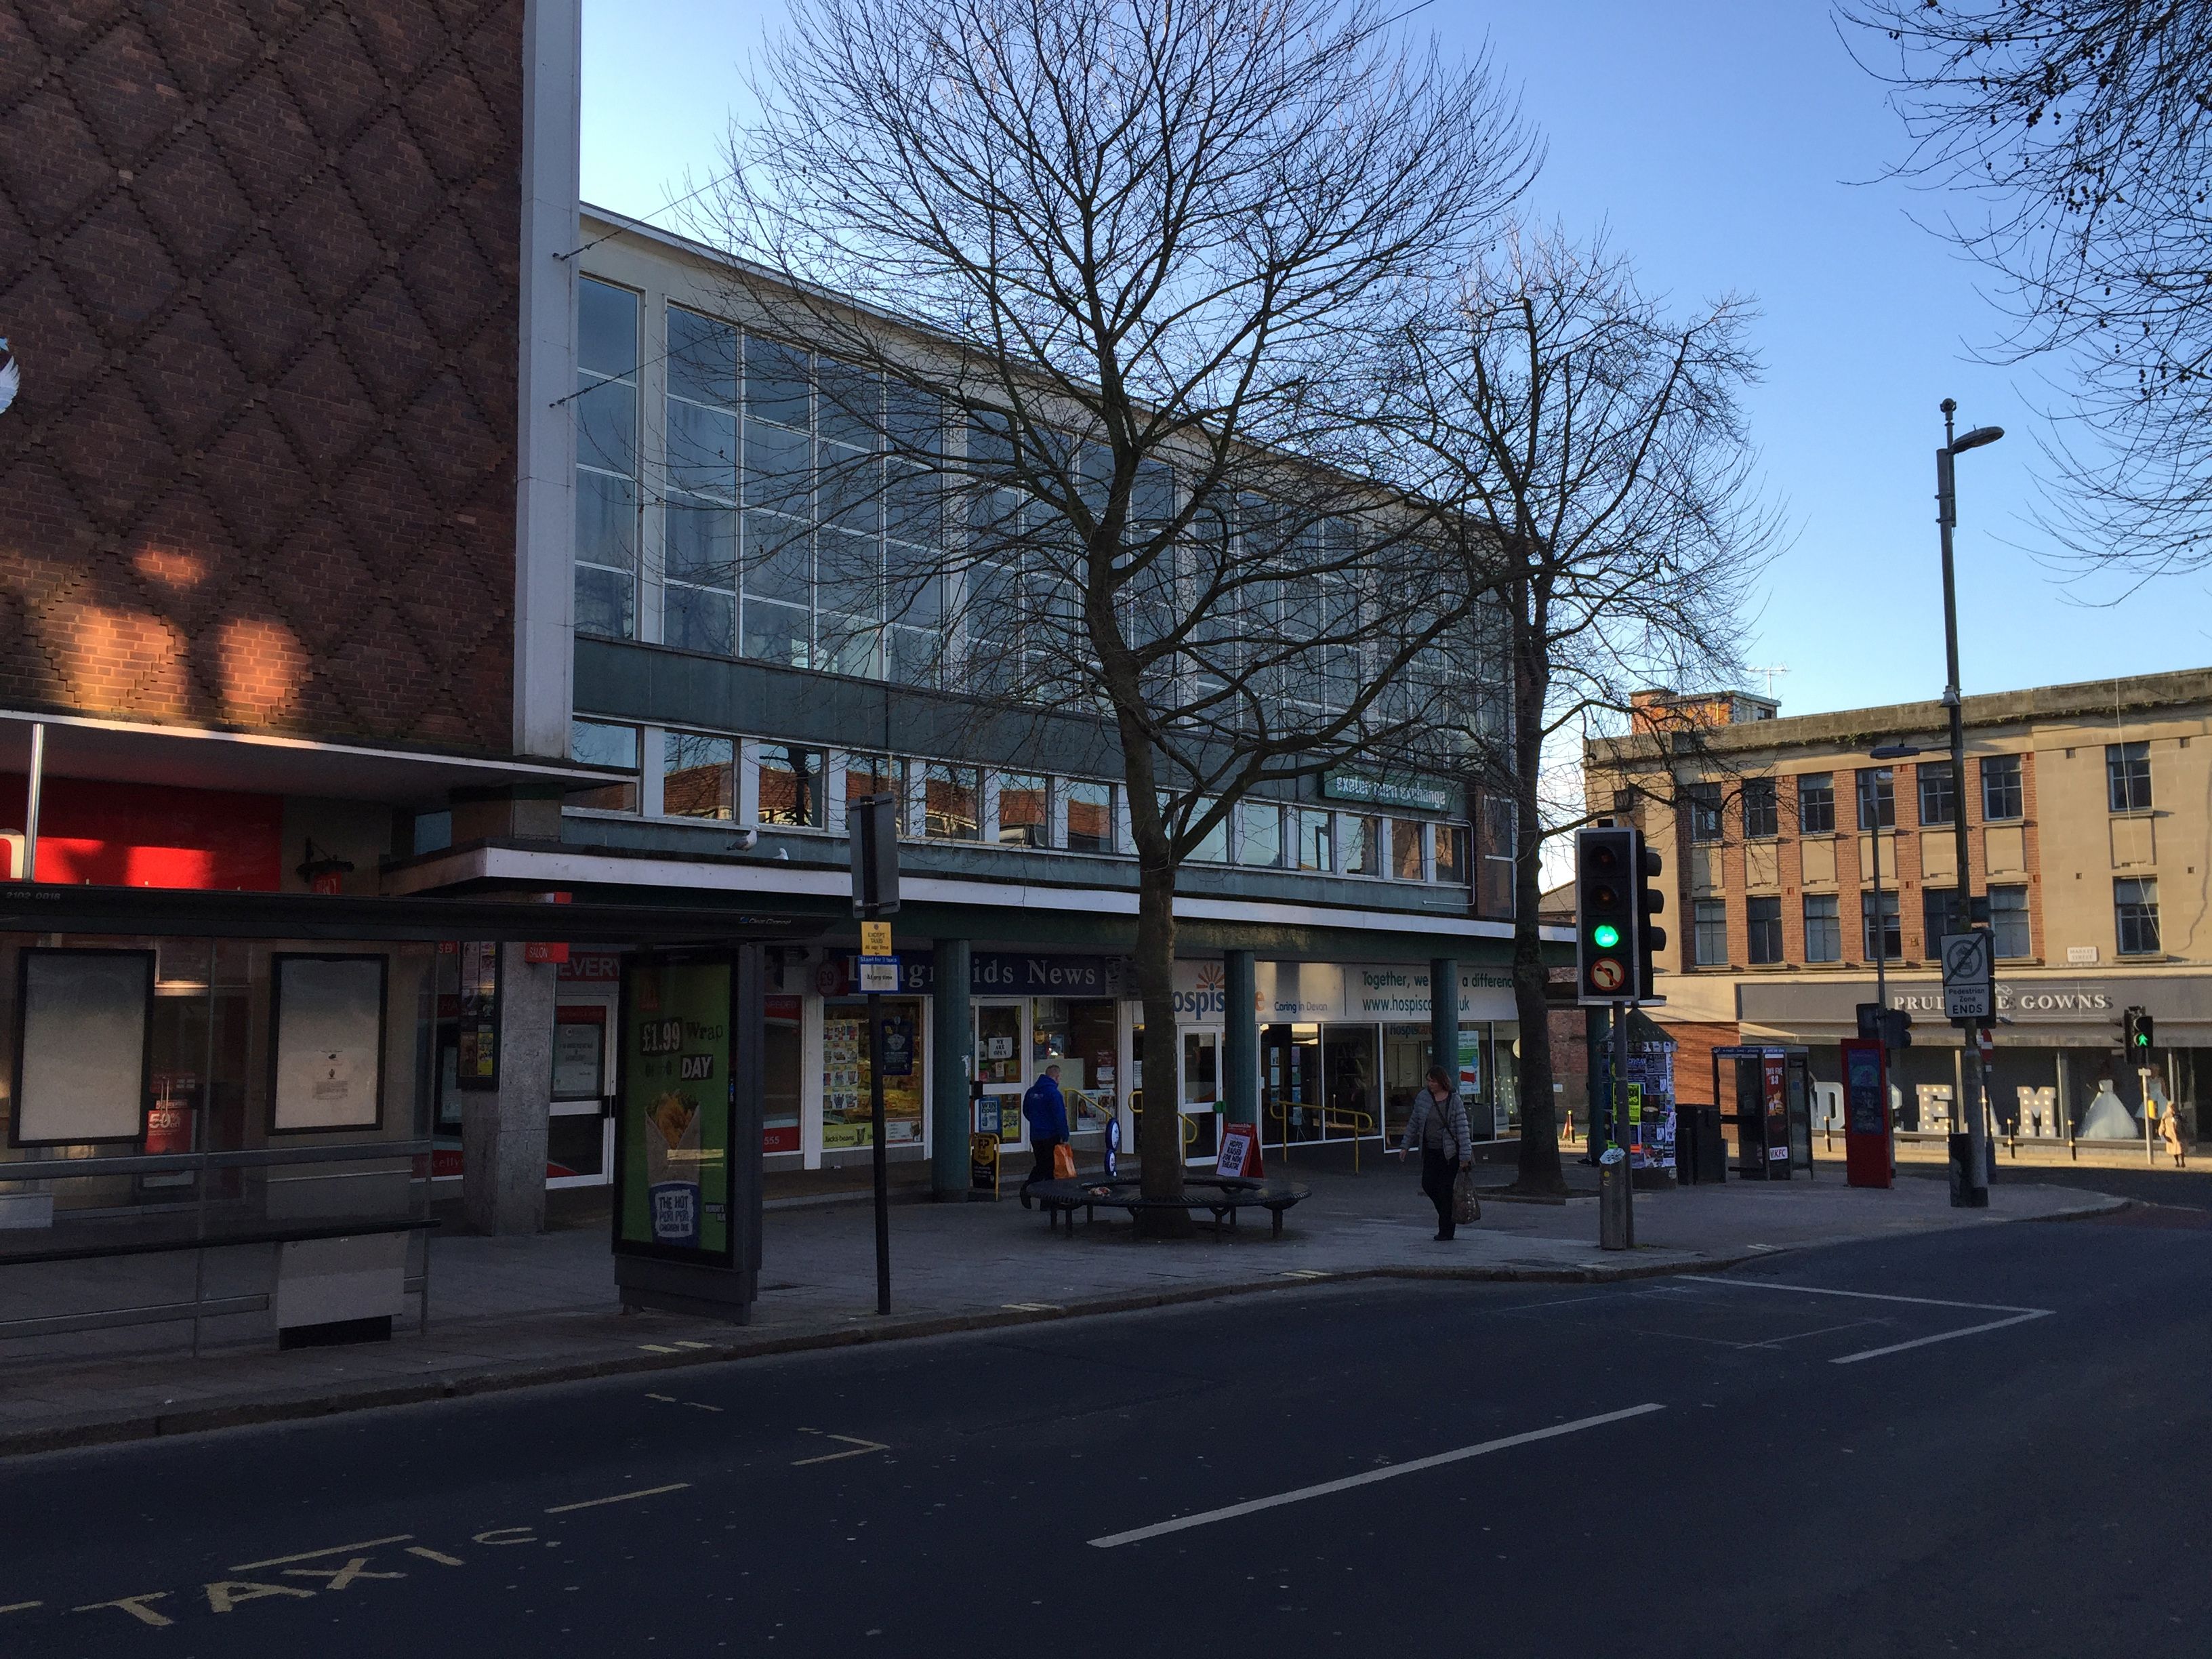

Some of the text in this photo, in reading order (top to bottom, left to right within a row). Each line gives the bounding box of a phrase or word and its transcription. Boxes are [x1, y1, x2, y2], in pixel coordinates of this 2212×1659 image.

[1399, 782, 1446, 808] exchange
[529, 948, 548, 958] SALON
[820, 970, 834, 987] £9
[1027, 958, 1096, 985] News
[1362, 970, 1515, 989] Together, we a differenc
[1274, 1002, 1328, 1014] Caring in Devon
[1952, 1004, 1983, 1015] ENDS
[2020, 994, 2106, 1010] GOWNS
[643, 1021, 723, 1052] £1.99 Wrap
[681, 1057, 712, 1079] DAY
[1774, 1149, 1786, 1158] KFC
[659, 1195, 689, 1210] THE HOT
